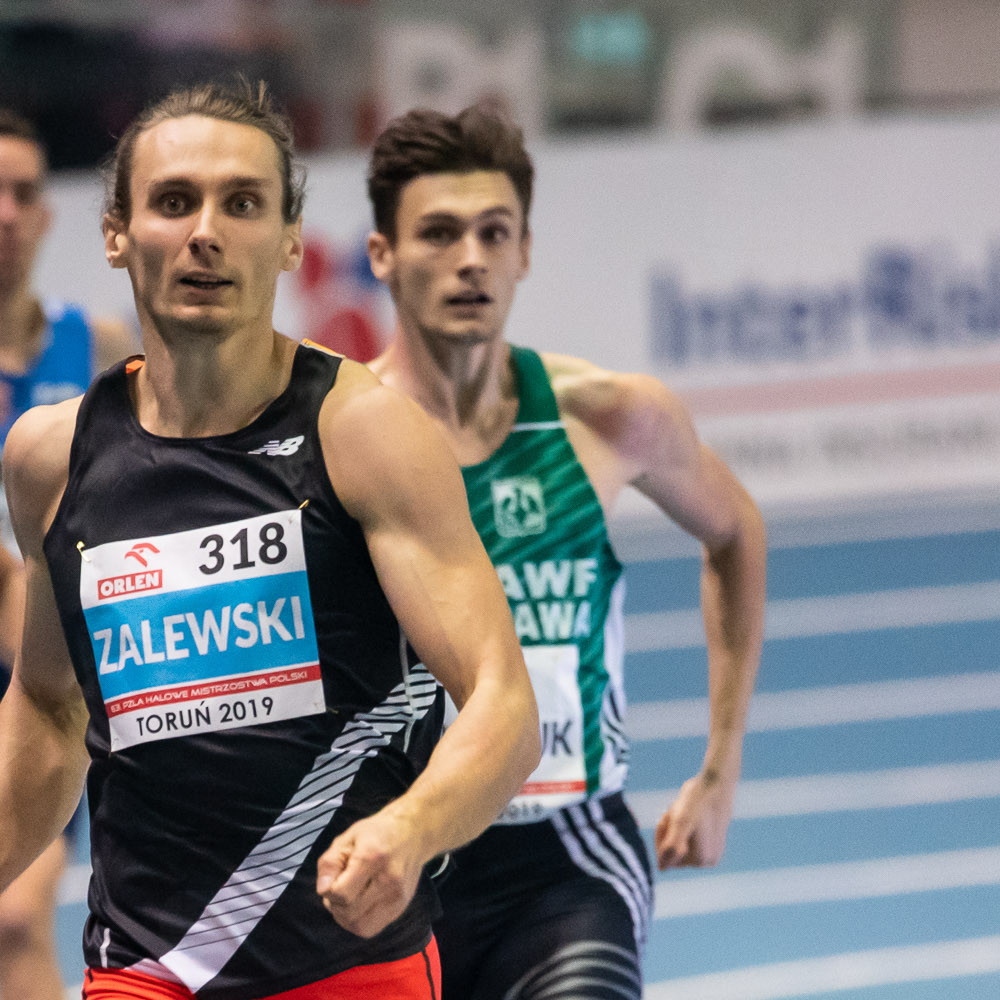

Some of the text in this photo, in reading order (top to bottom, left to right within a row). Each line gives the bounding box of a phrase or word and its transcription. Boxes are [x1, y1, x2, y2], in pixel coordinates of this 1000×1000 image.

[199, 522, 288, 575] 318
[100, 572, 160, 597] ORLEN
[494, 557, 598, 601] AWF
[93, 596, 306, 675] ZALEWSKI
[145, 690, 189, 704] HALOWE
[190, 678, 268, 697] MISTRZOSTWA
[269, 671, 308, 684] POLSKI
[136, 696, 274, 736] TORUŃ 2019
